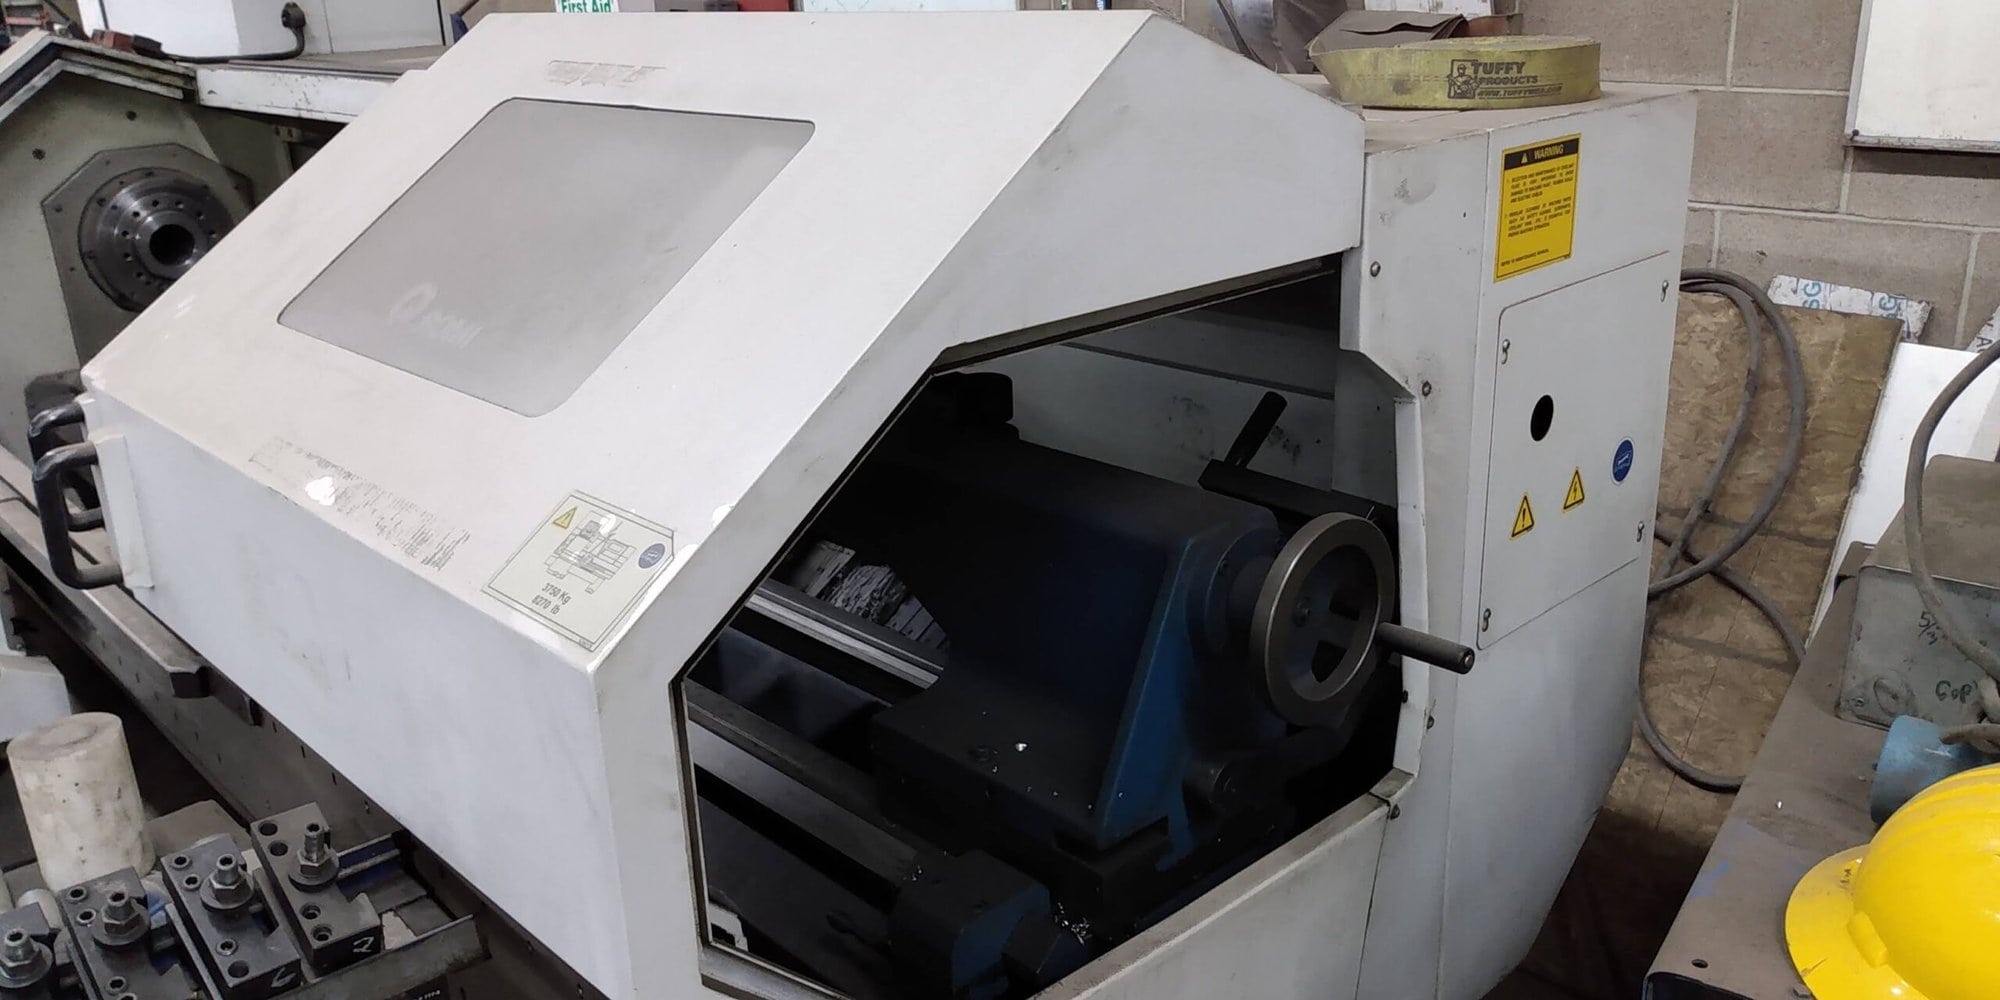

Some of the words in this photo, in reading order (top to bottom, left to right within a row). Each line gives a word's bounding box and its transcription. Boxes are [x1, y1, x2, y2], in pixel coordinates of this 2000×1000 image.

[561, 0, 587, 13] First
[592, 0, 612, 13] Aid
[1471, 61, 1526, 75] TUFFY
[1478, 75, 1539, 86] PRODUCTS
[1534, 144, 1564, 160] WARNING
[541, 582, 562, 598] 3750
[559, 591, 572, 606] Kg
[353, 936, 375, 953] 2
